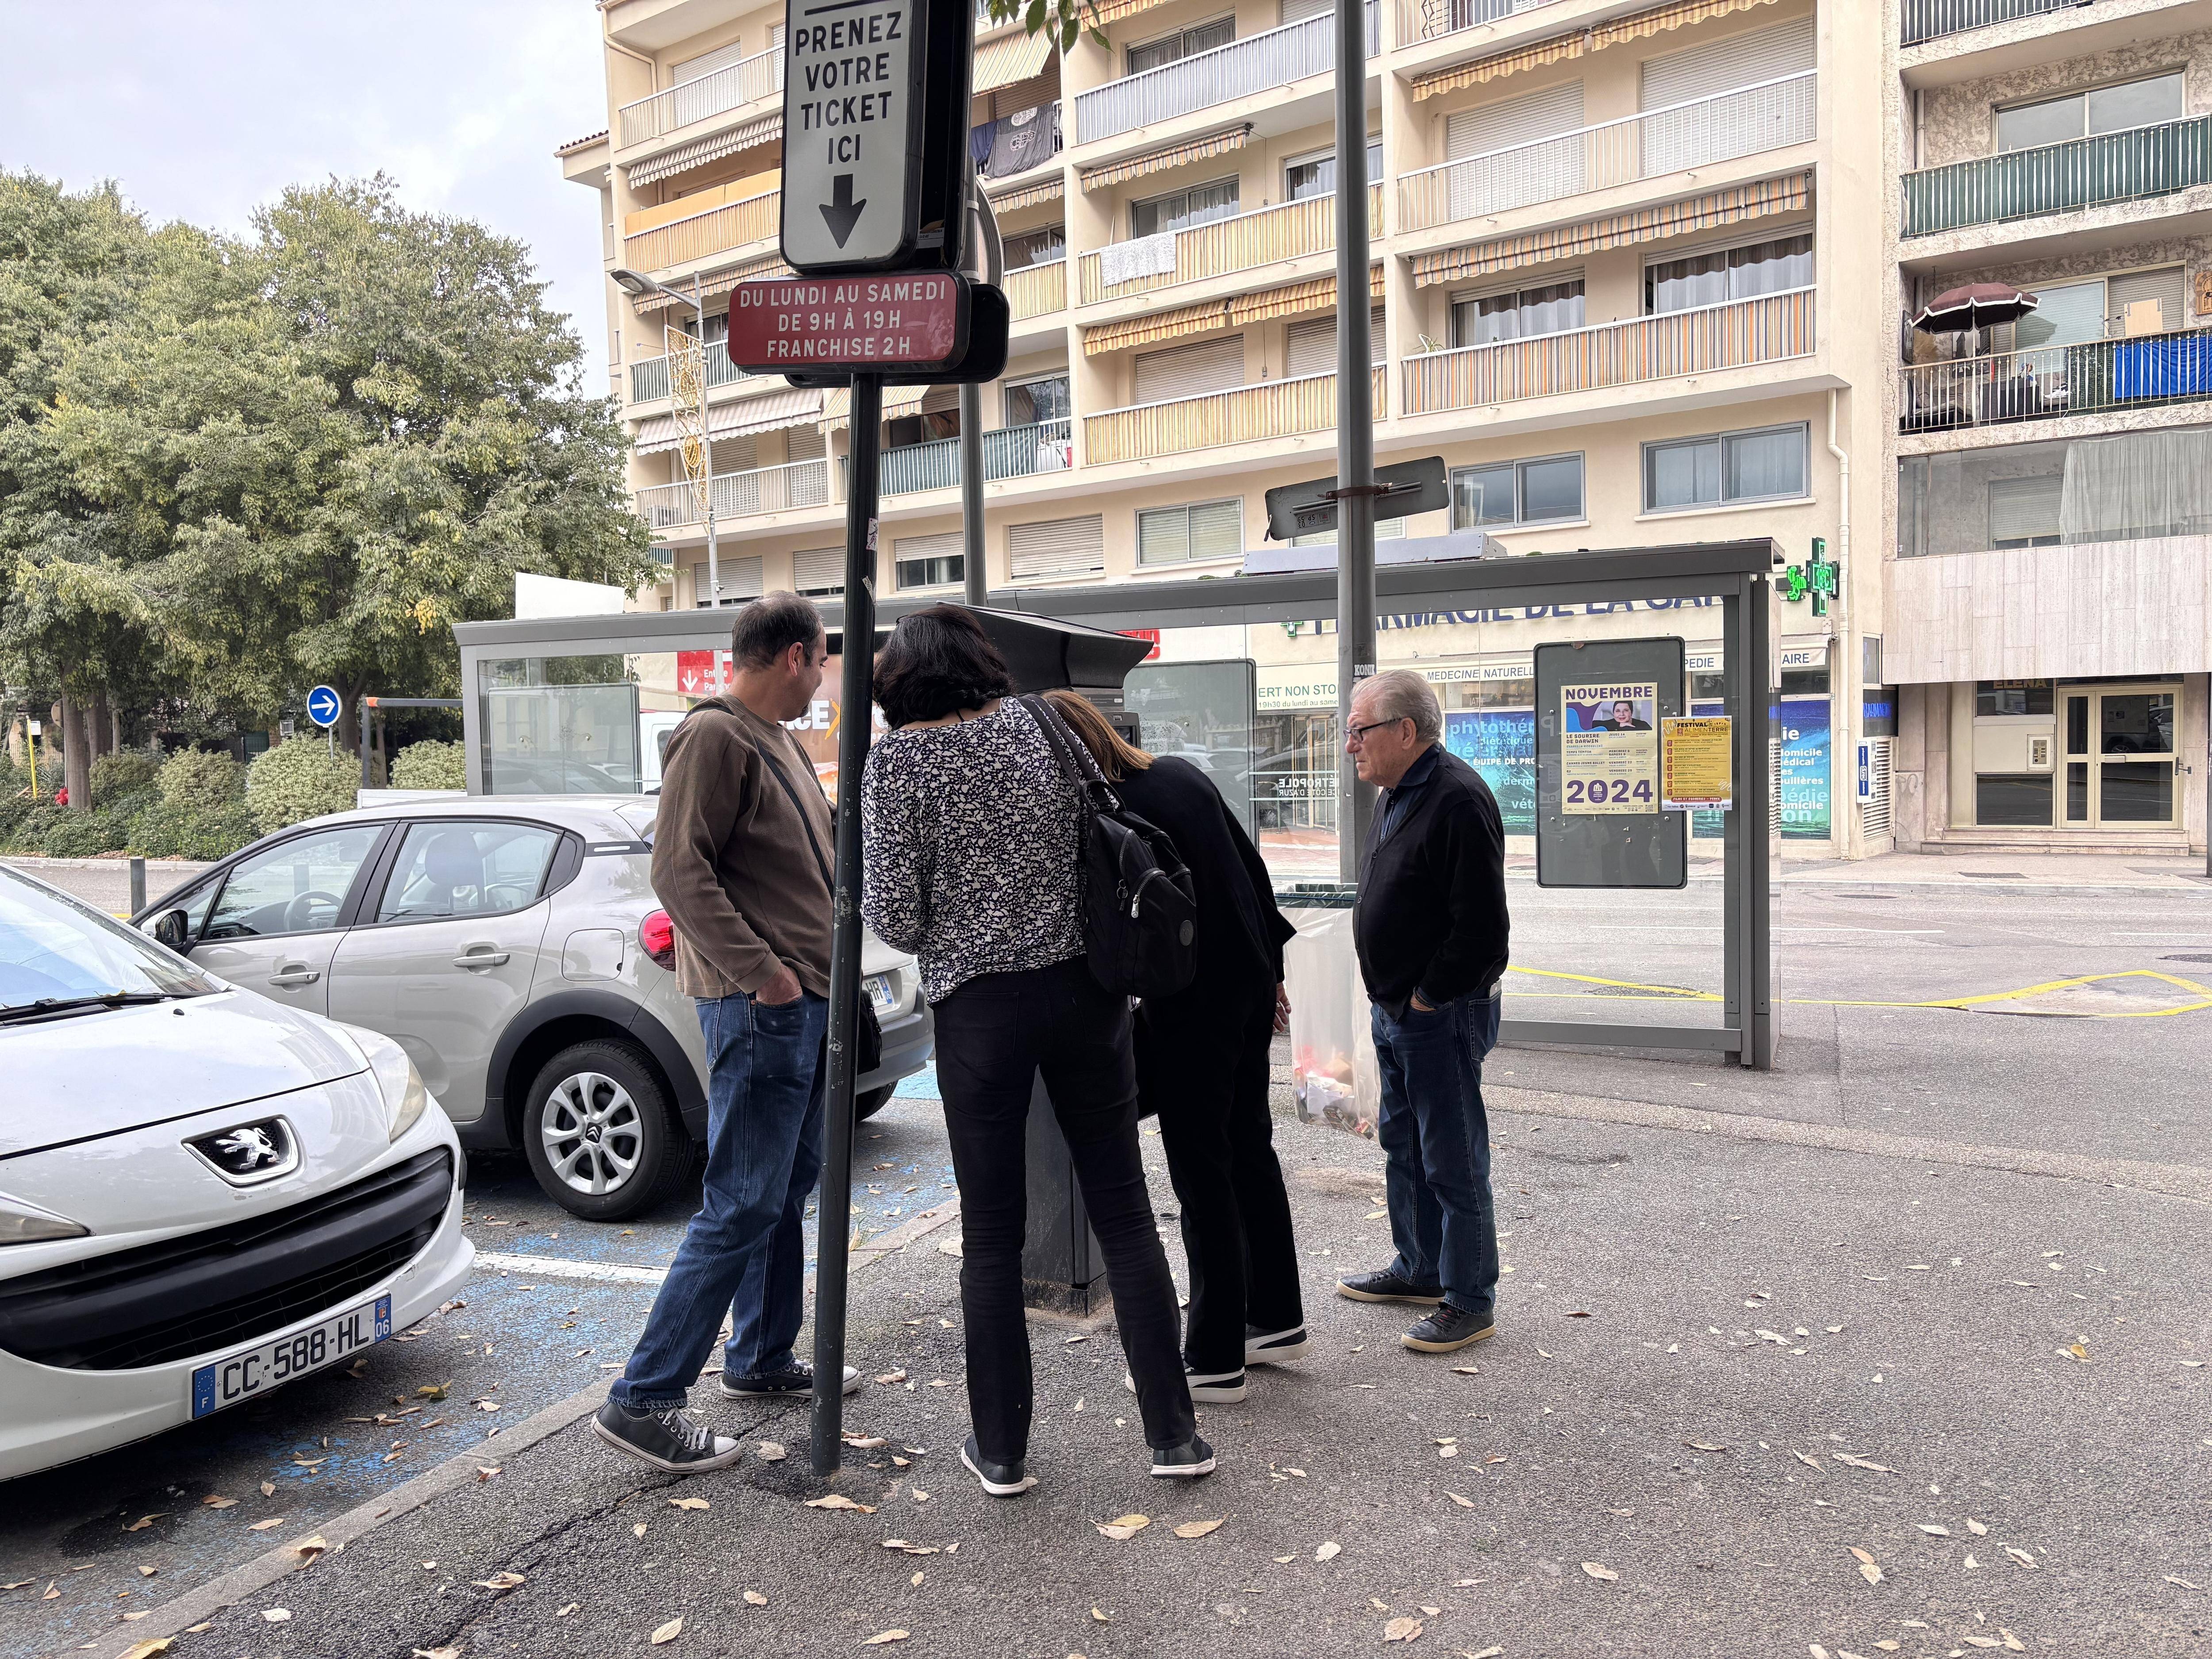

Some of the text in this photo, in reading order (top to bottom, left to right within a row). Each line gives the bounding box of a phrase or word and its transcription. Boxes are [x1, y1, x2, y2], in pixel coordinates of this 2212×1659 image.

[795, 11, 901, 56] PRENEZ
[805, 52, 889, 92] VOTRE
[801, 91, 891, 130] TICKET
[829, 134, 860, 164] ICI
[741, 281, 945, 307] DU LUNDI AU SAMEDI
[779, 307, 900, 331] DE 9H À 19H
[768, 336, 910, 358] FRANCHISE 2H
[1782, 653, 1810, 664] AIRE
[1427, 666, 1534, 680] MEDECINE NATURELL
[1993, 679, 2047, 689] ELENA
[1286, 685, 1310, 696] NON
[1313, 684, 1338, 695] STO
[1566, 686, 1652, 700] NOVEMBRE
[1781, 757, 1814, 766] édical
[1567, 779, 1653, 803] 2024
[1511, 798, 1535, 809] vét
[202, 1314, 389, 1408] F CC-588-HL 06
